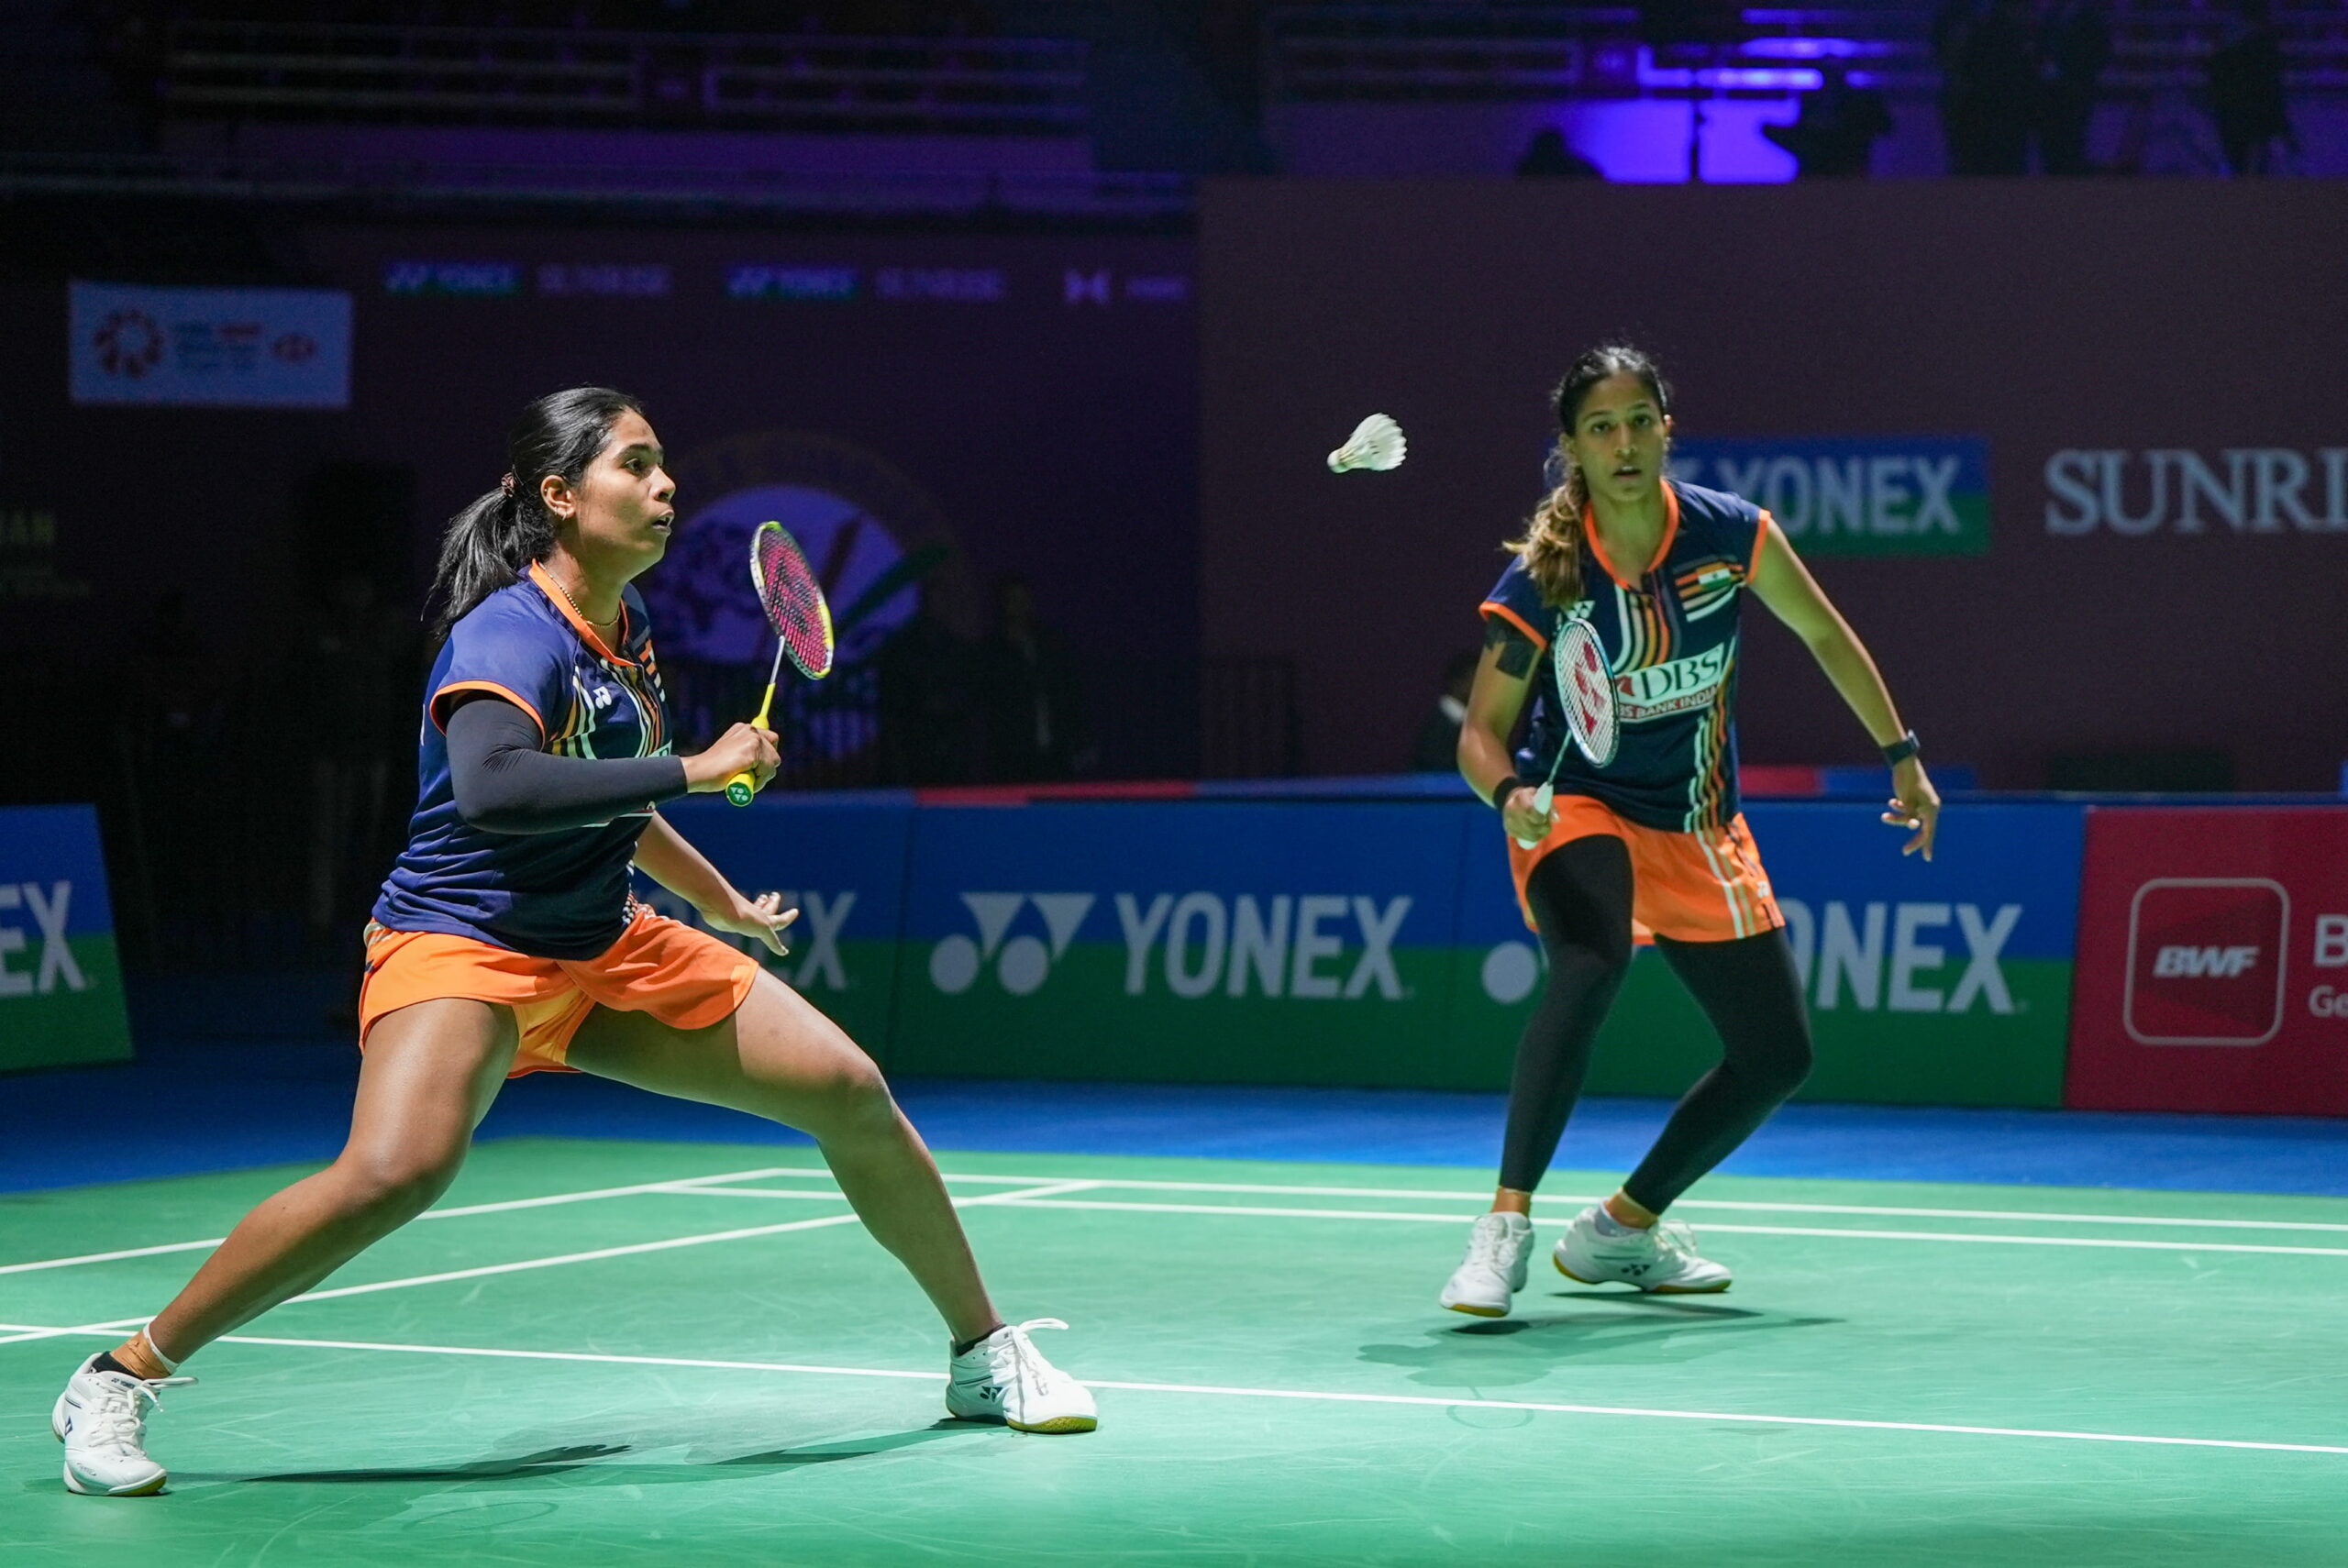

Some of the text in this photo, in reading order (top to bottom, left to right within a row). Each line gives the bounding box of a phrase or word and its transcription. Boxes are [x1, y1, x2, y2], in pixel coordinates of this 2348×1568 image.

[1714, 455, 1962, 537] YONEX
[1641, 652, 1718, 700] DBS
[1637, 700, 1678, 717] BANK
[1113, 892, 1413, 999] YONEX
[2153, 945, 2260, 978] BWF
